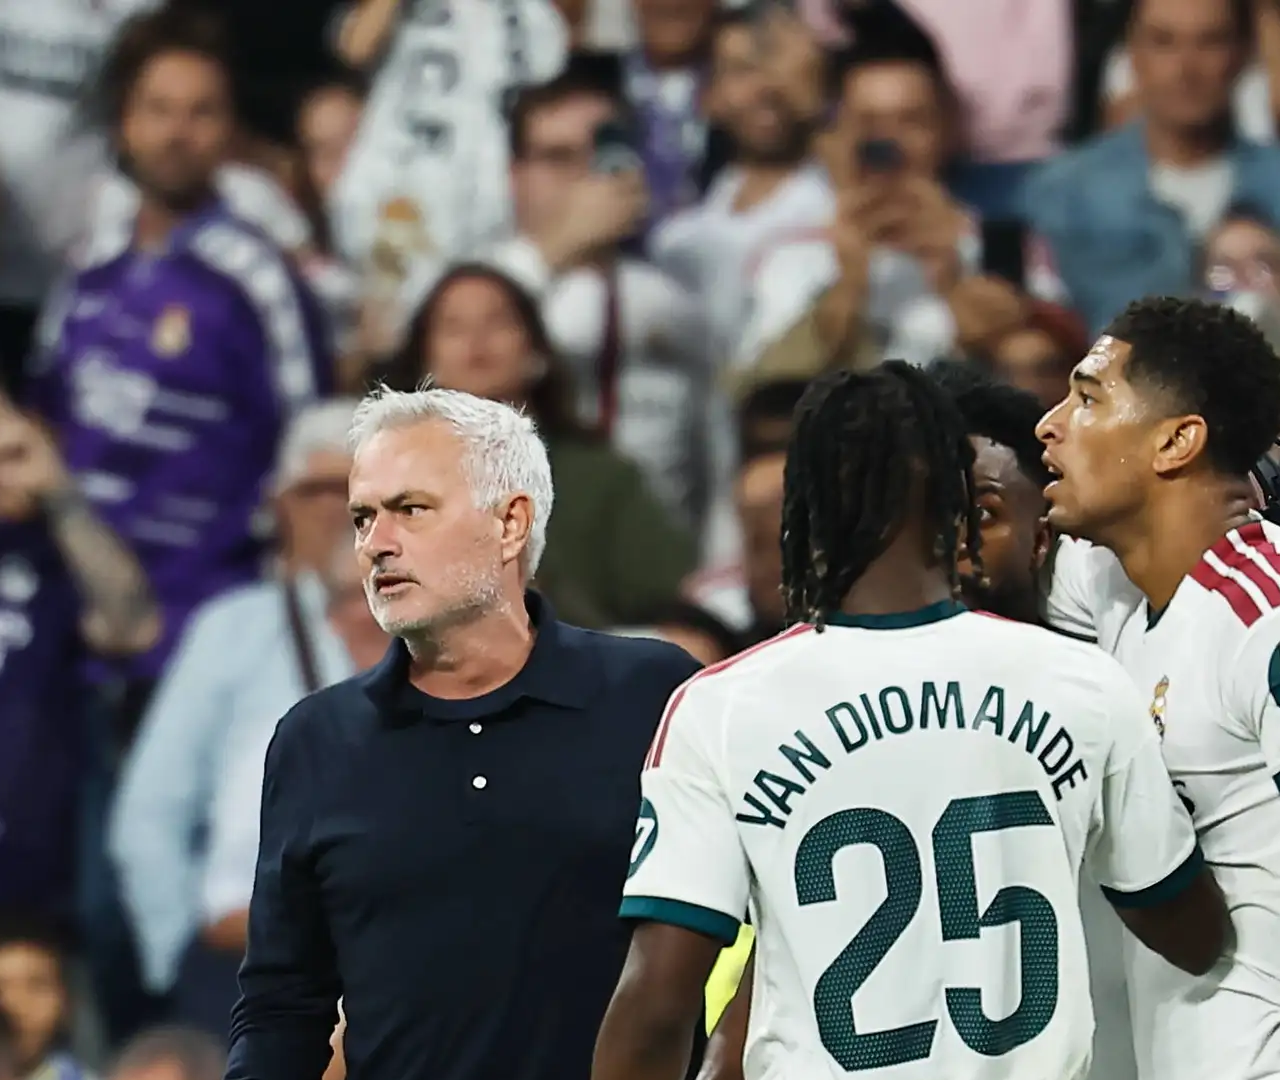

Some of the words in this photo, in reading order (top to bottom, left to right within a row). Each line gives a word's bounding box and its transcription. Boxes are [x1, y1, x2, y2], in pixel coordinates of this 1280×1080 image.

[735, 729, 832, 829] YAN
[825, 681, 1088, 801] DIOMANDE
[794, 790, 1060, 1072] 25
